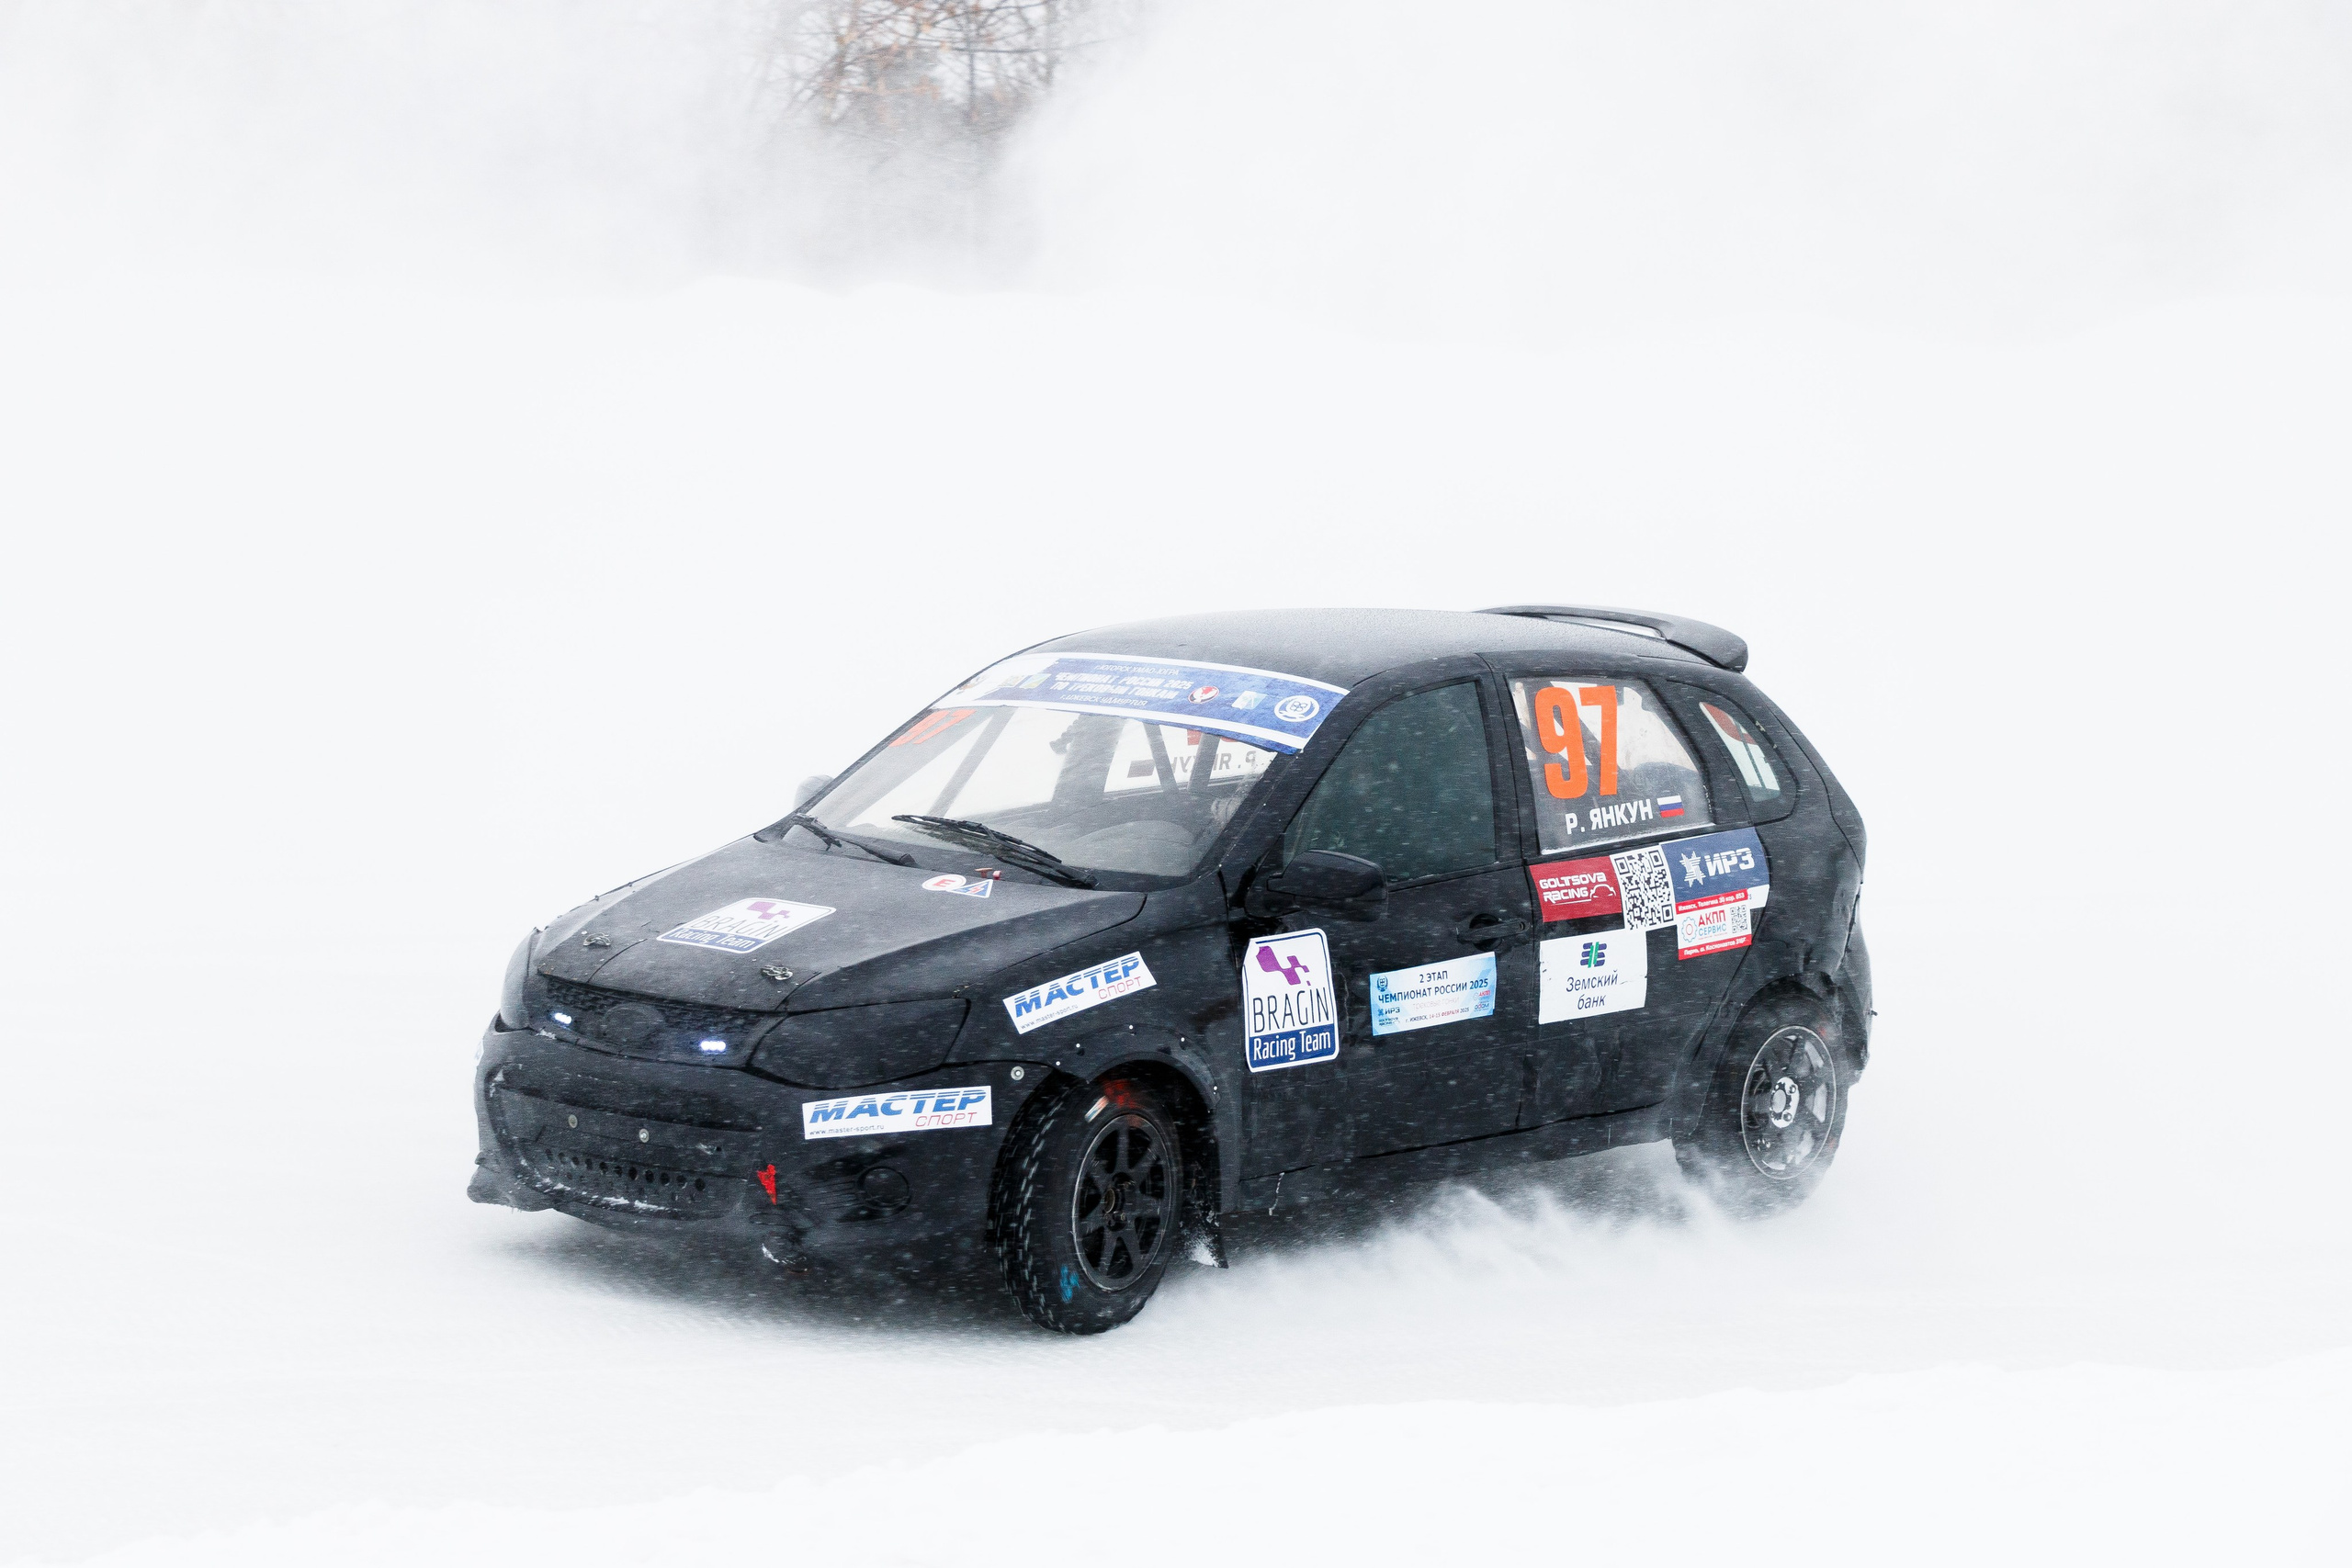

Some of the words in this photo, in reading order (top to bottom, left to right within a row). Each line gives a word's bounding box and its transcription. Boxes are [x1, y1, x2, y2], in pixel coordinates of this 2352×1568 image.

[1049, 681, 1070, 690] ПО
[1127, 687, 1181, 700] ГОНКАМ
[1117, 676, 1165, 687] РОССИИ
[1163, 679, 1194, 690] 2025
[888, 709, 977, 747] 97
[1534, 685, 1618, 799] 97
[1565, 812, 1586, 834] Р.
[1589, 798, 1654, 830] ЯНКУН
[1704, 847, 1755, 876] ИРЗ
[690, 915, 788, 939] BRAGIN
[1699, 909, 1726, 927] АКПП
[1699, 923, 1727, 936] СЕРВИС
[670, 929, 720, 944] Racing
[716, 934, 756, 949] Team
[1013, 955, 1140, 1018] МАСТЕР
[1098, 976, 1141, 1000] СПОРТ
[1419, 975, 1424, 984] 2
[1427, 970, 1448, 982] ЭТАП
[1566, 969, 1618, 992] Земский
[1378, 987, 1432, 1003] ЧЕМПИОНАТ
[1434, 982, 1467, 996] РОССИИ
[1469, 978, 1488, 990] 2025
[1577, 994, 1606, 1010] банк
[1020, 1003, 1079, 1030] www.master-sport.ru
[1252, 987, 1329, 1033] BRAGIN
[1253, 1035, 1296, 1061] Racing
[1299, 1031, 1331, 1053] Team
[808, 1089, 987, 1123] МАСТЕР
[808, 1124, 885, 1135] www.master-sport.ru
[915, 1111, 978, 1127] СПОРТ
